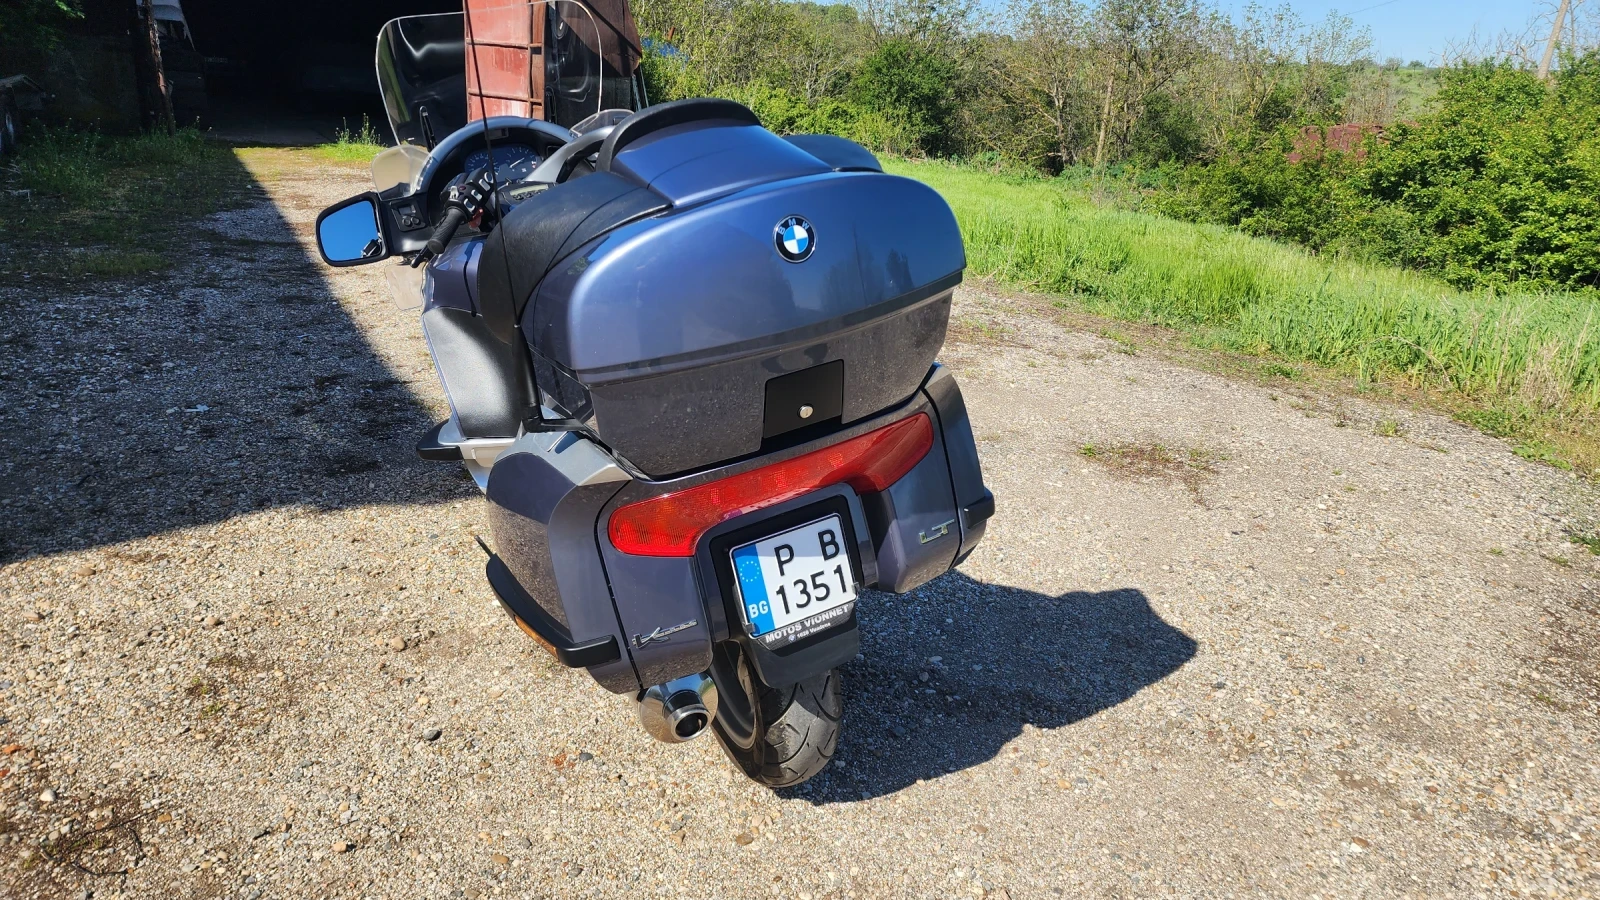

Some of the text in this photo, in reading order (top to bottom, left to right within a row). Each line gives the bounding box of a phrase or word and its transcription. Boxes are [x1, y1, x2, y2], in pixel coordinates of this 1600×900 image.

[777, 218, 810, 236] BMW
[774, 529, 840, 577] P B
[776, 564, 847, 615] 1351
[748, 600, 769, 619] BG
[765, 604, 849, 643] MOTOS VIONNET
